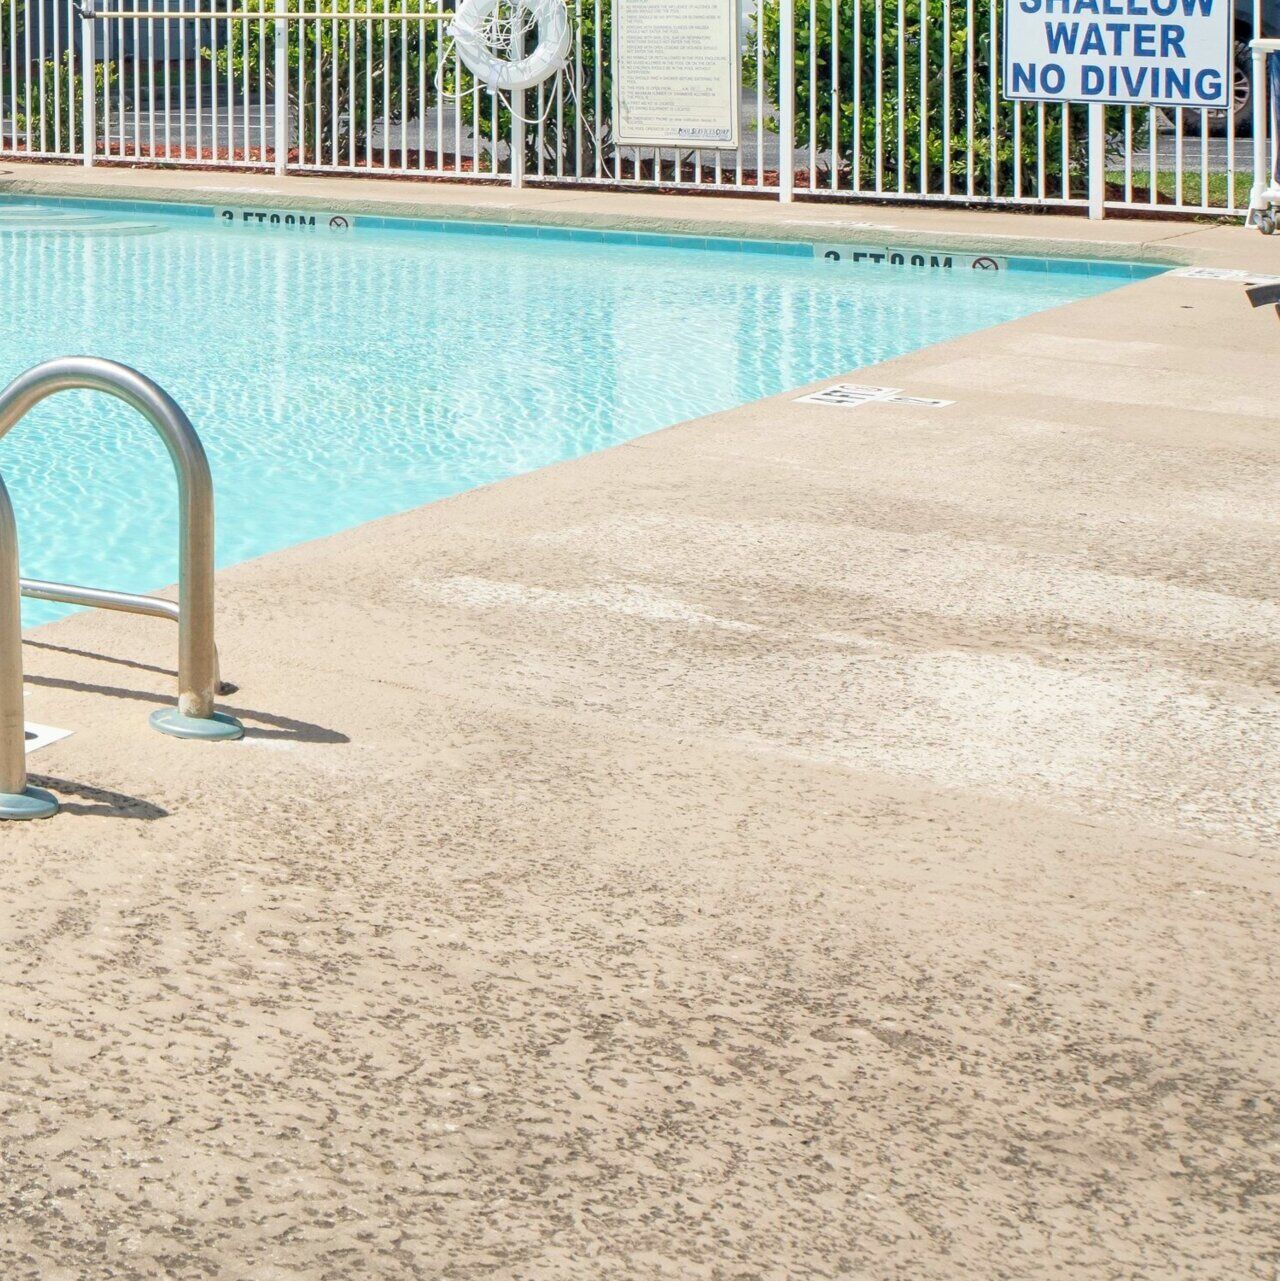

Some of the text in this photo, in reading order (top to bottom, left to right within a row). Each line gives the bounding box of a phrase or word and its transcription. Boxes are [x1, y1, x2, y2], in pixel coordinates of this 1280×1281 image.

[1045, 22, 1186, 58] WATER
[1012, 63, 1222, 100] NO DIVING
